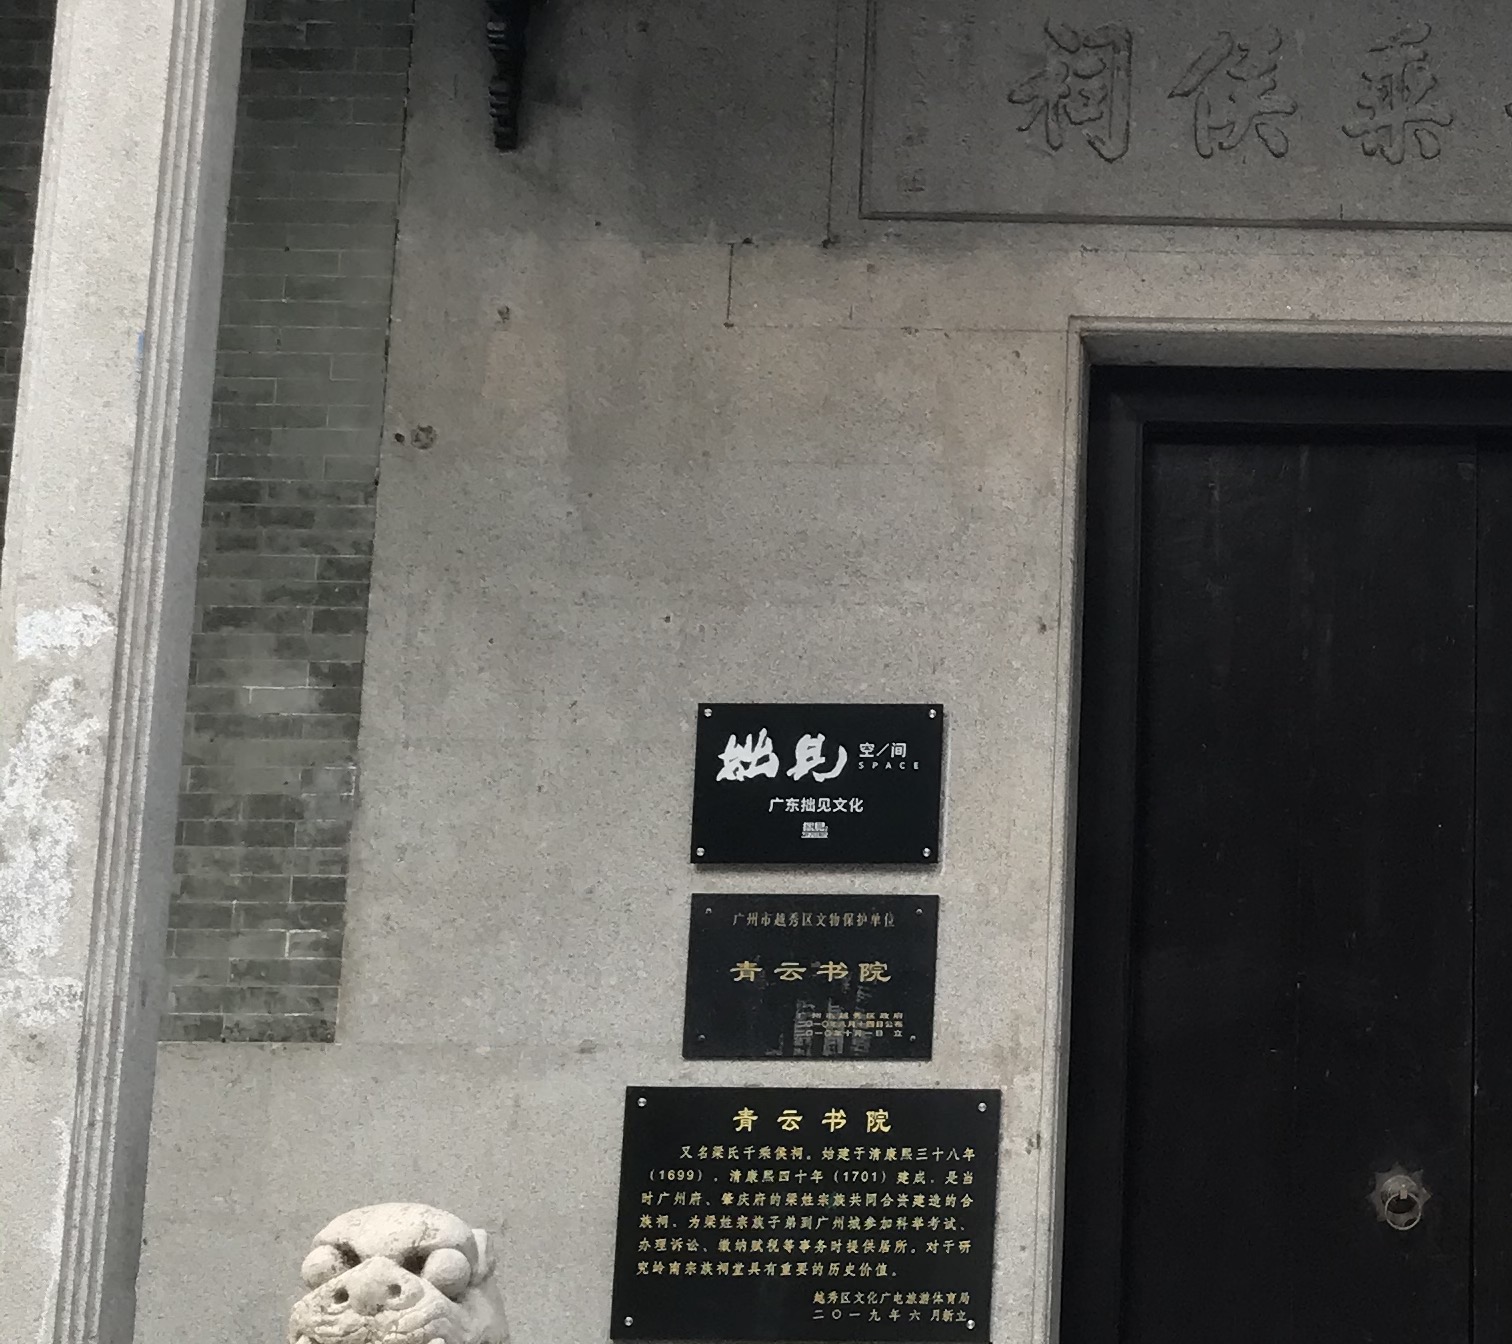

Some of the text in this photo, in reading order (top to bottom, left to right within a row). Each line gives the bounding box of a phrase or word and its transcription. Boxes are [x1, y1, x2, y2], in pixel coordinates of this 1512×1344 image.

[858, 761, 920, 770] SPACE
[768, 796, 864, 813] 广东拙见文化
[732, 911, 896, 928] 广州市越秀区文物保护单位
[729, 960, 892, 983] 青云书院
[732, 1106, 892, 1133] 青云书院
[812, 1290, 970, 1305] 越秀区文化广电旅游体育局
